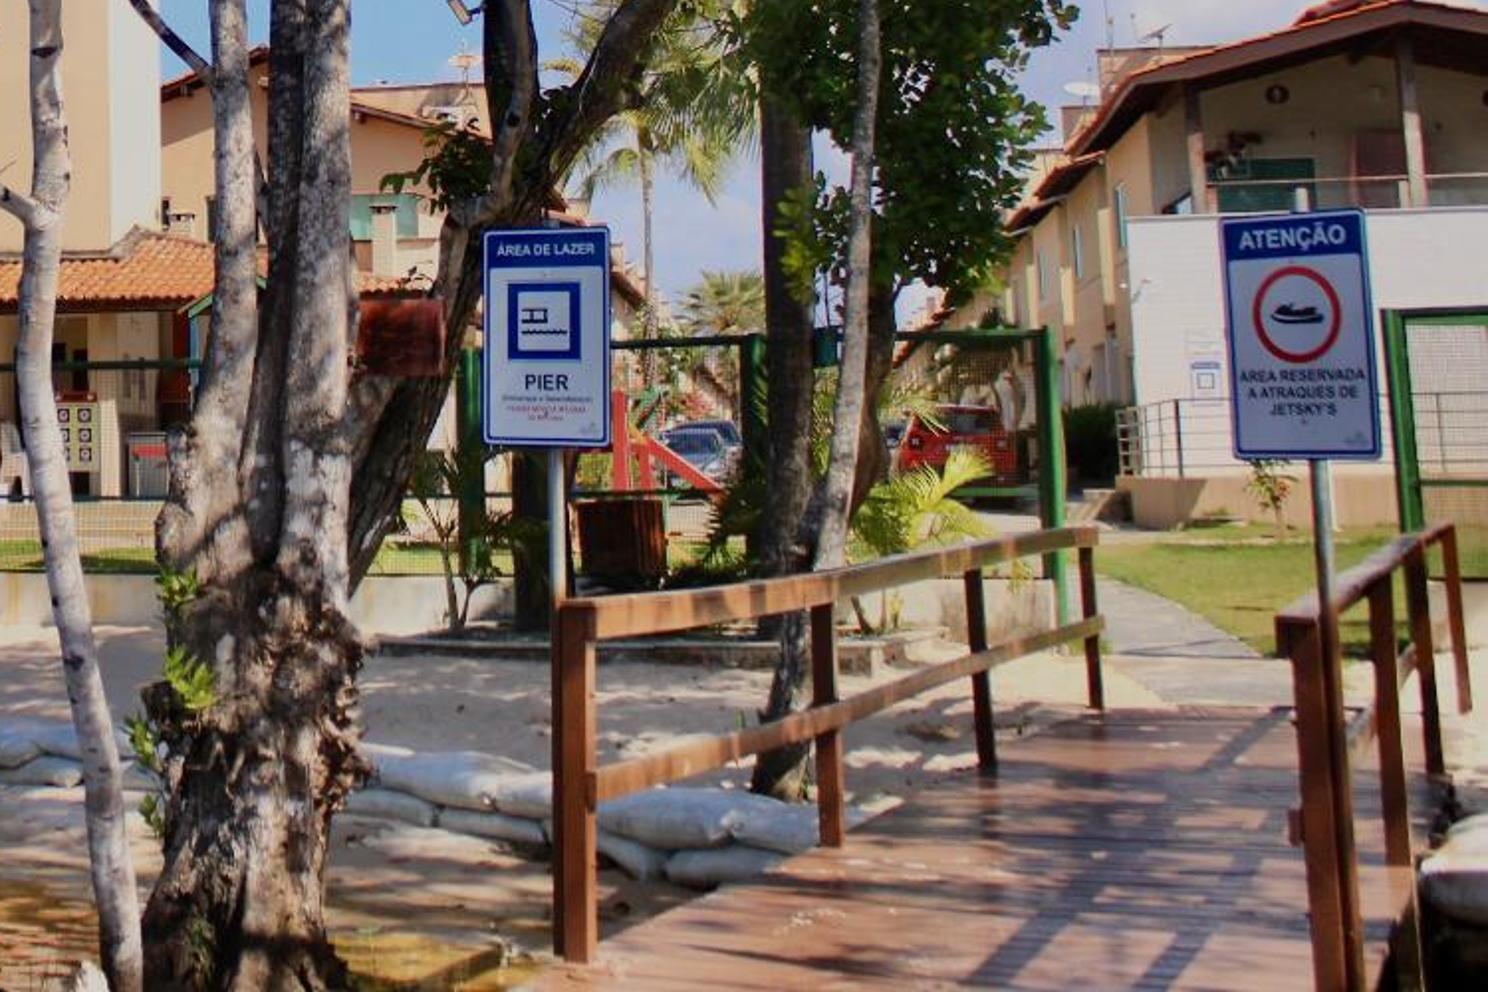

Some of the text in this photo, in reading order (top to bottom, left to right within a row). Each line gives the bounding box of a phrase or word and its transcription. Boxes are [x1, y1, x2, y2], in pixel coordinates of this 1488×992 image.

[1238, 222, 1346, 251] ATENÇÃO
[497, 241, 595, 257] ÁREA DE LAZER
[525, 374, 569, 391] PIER
[1278, 368, 1365, 382] RESERVADA
[1248, 385, 1359, 399] A ATRAQUES DE
